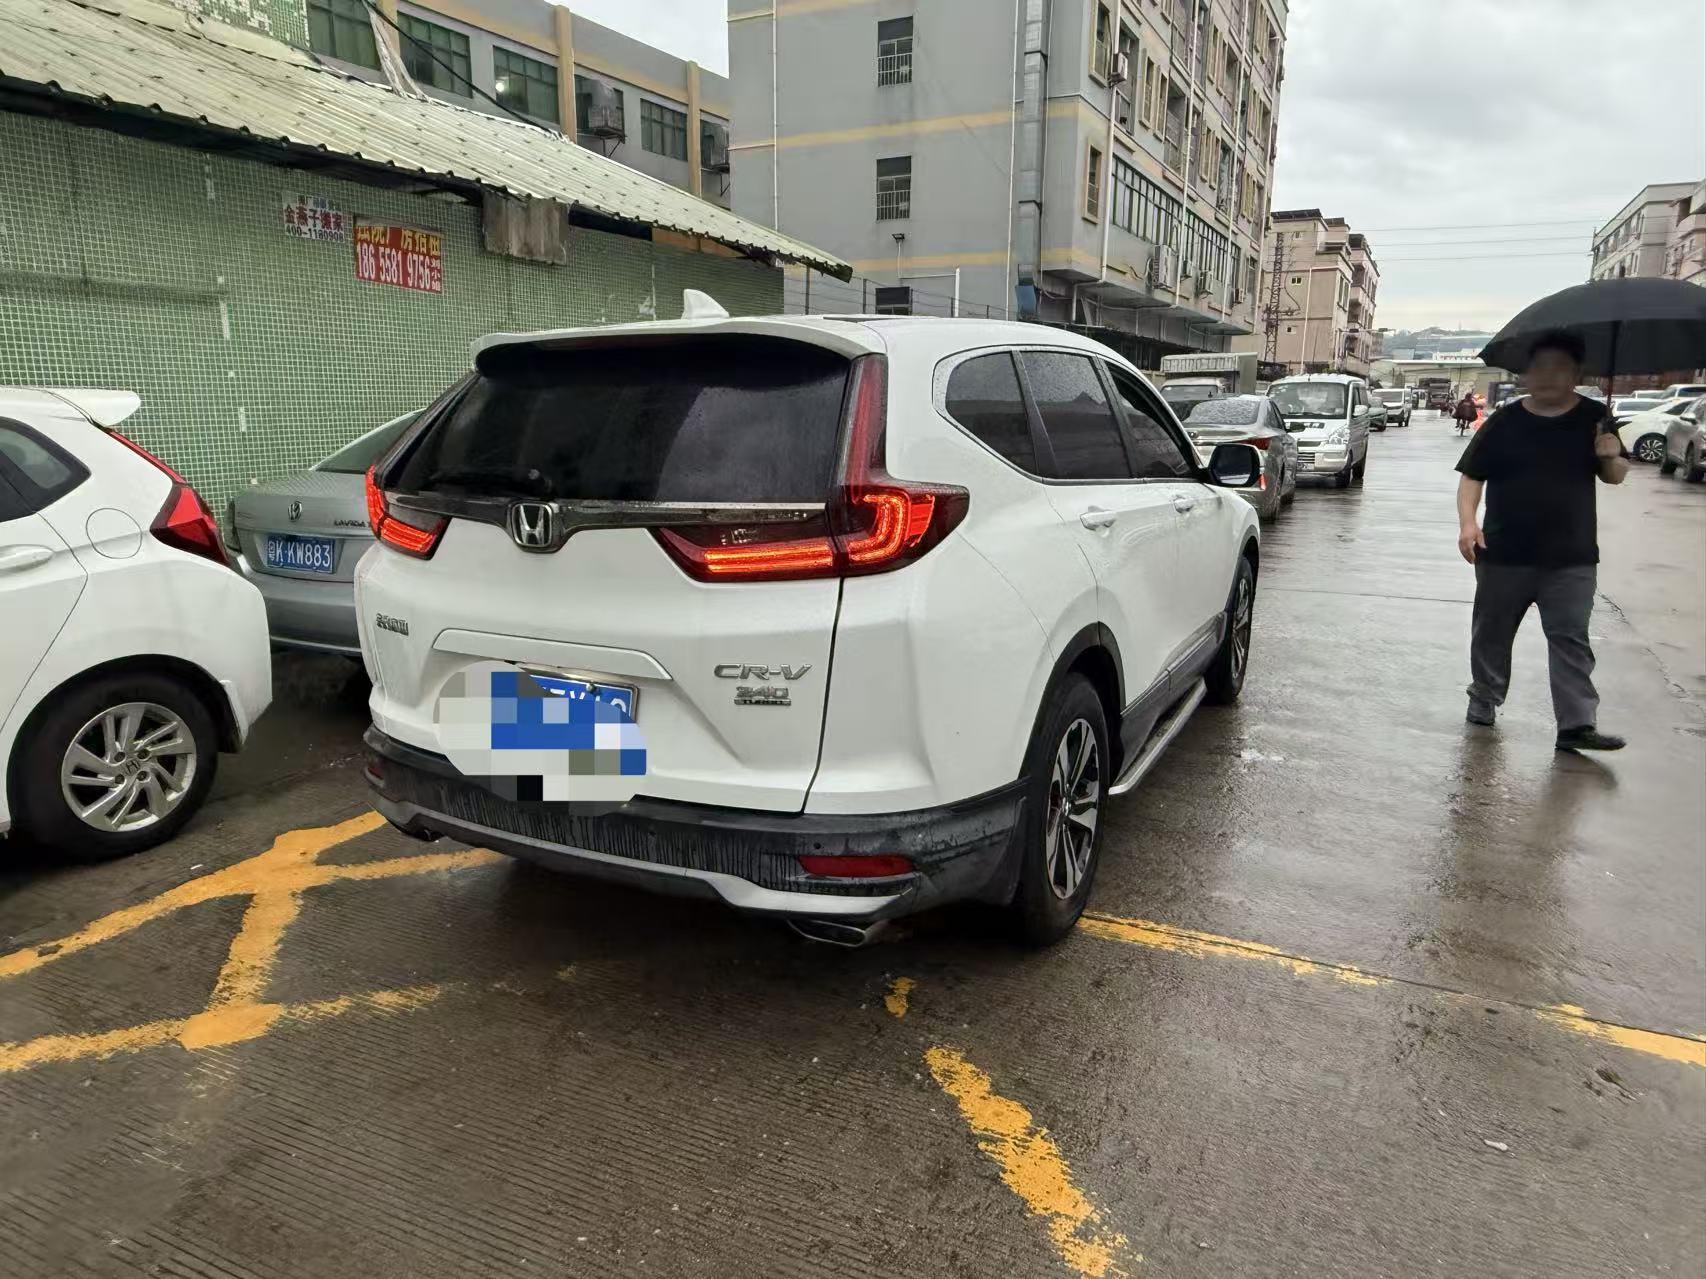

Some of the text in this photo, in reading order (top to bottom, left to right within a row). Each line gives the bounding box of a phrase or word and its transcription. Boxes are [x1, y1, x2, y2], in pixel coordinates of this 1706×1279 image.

[357, 241, 431, 290] 186 5581 9756
[714, 663, 812, 680] CR-V
[736, 686, 789, 699] 240
